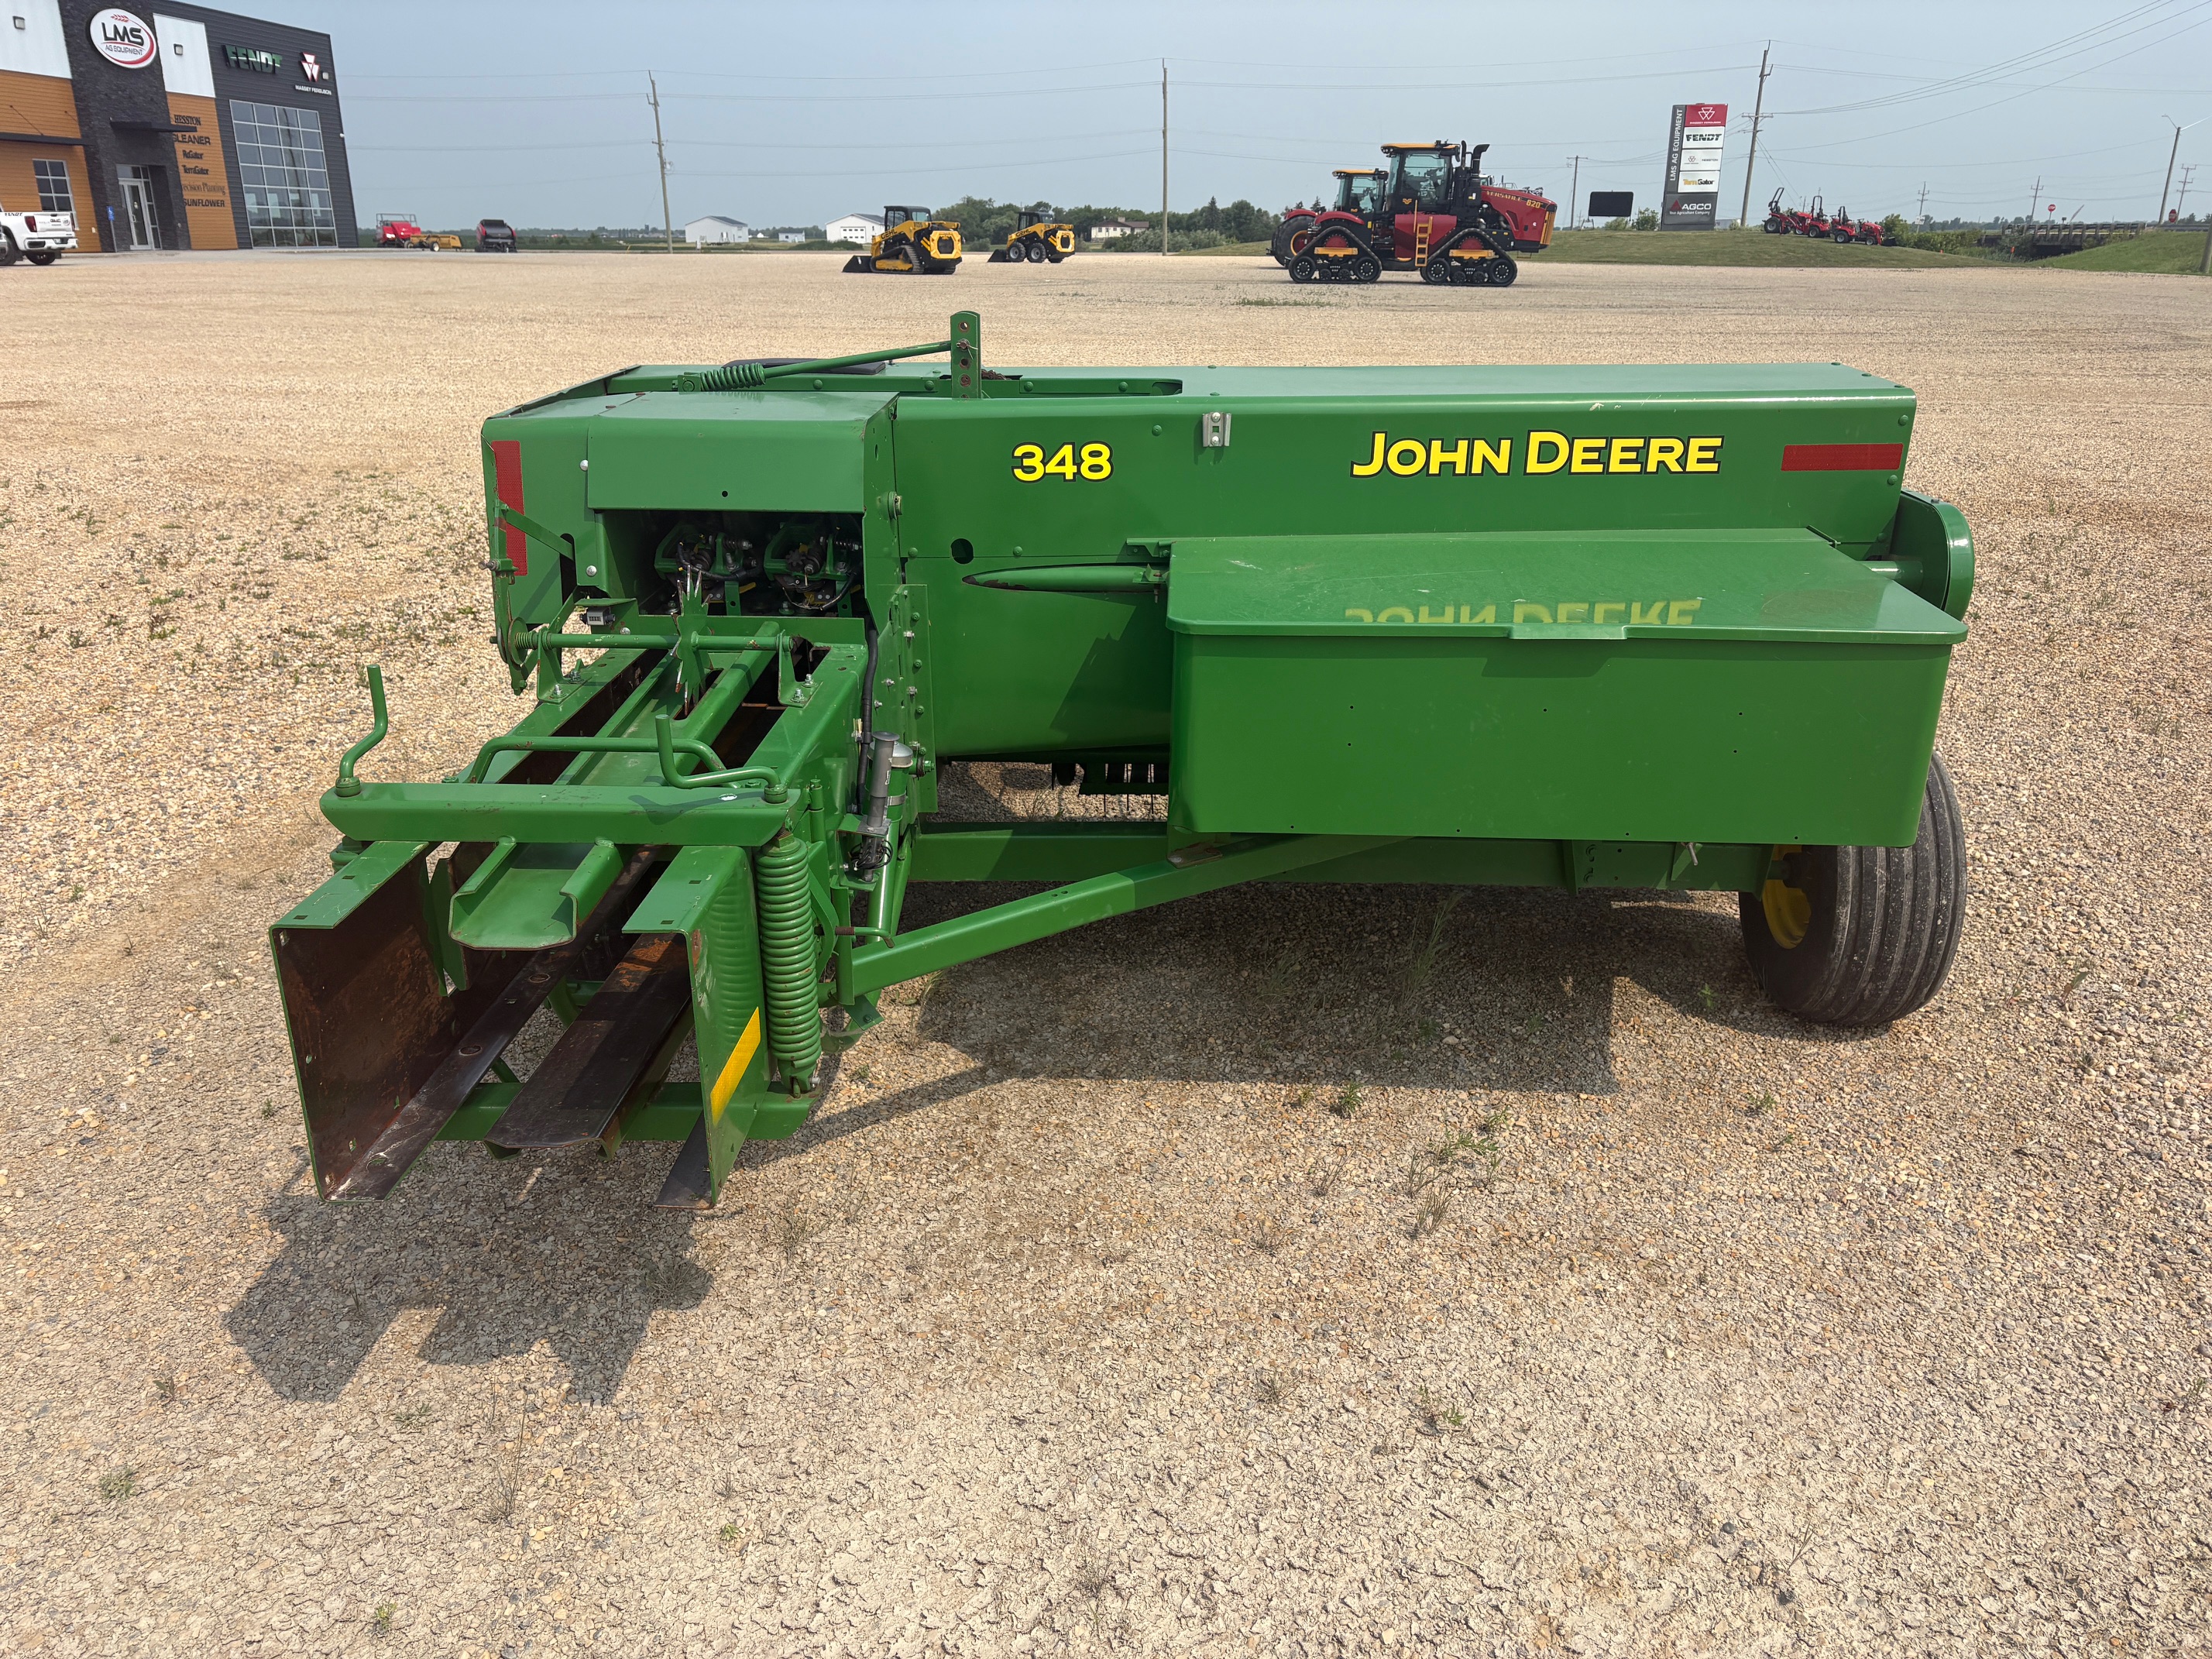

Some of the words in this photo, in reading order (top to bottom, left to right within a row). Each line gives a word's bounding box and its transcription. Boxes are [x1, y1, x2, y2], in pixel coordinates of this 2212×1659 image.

[101, 22, 144, 46] LMS
[113, 46, 143, 55] EQUIPMENT
[224, 45, 283, 73] FENDT
[174, 115, 201, 125] HESSTON
[1673, 108, 1683, 152] EQUIPMENT
[1686, 133, 1722, 142] FENDT
[1672, 153, 1679, 164] AG
[1669, 165, 1678, 182] LMS
[1487, 191, 1522, 201] VERSATILE
[184, 198, 225, 207] SUNFLOWER
[881, 229, 898, 239] GEHL
[1351, 431, 1513, 476] JOHN
[1523, 429, 1725, 476] DEERE
[1012, 441, 1113, 483] 348
